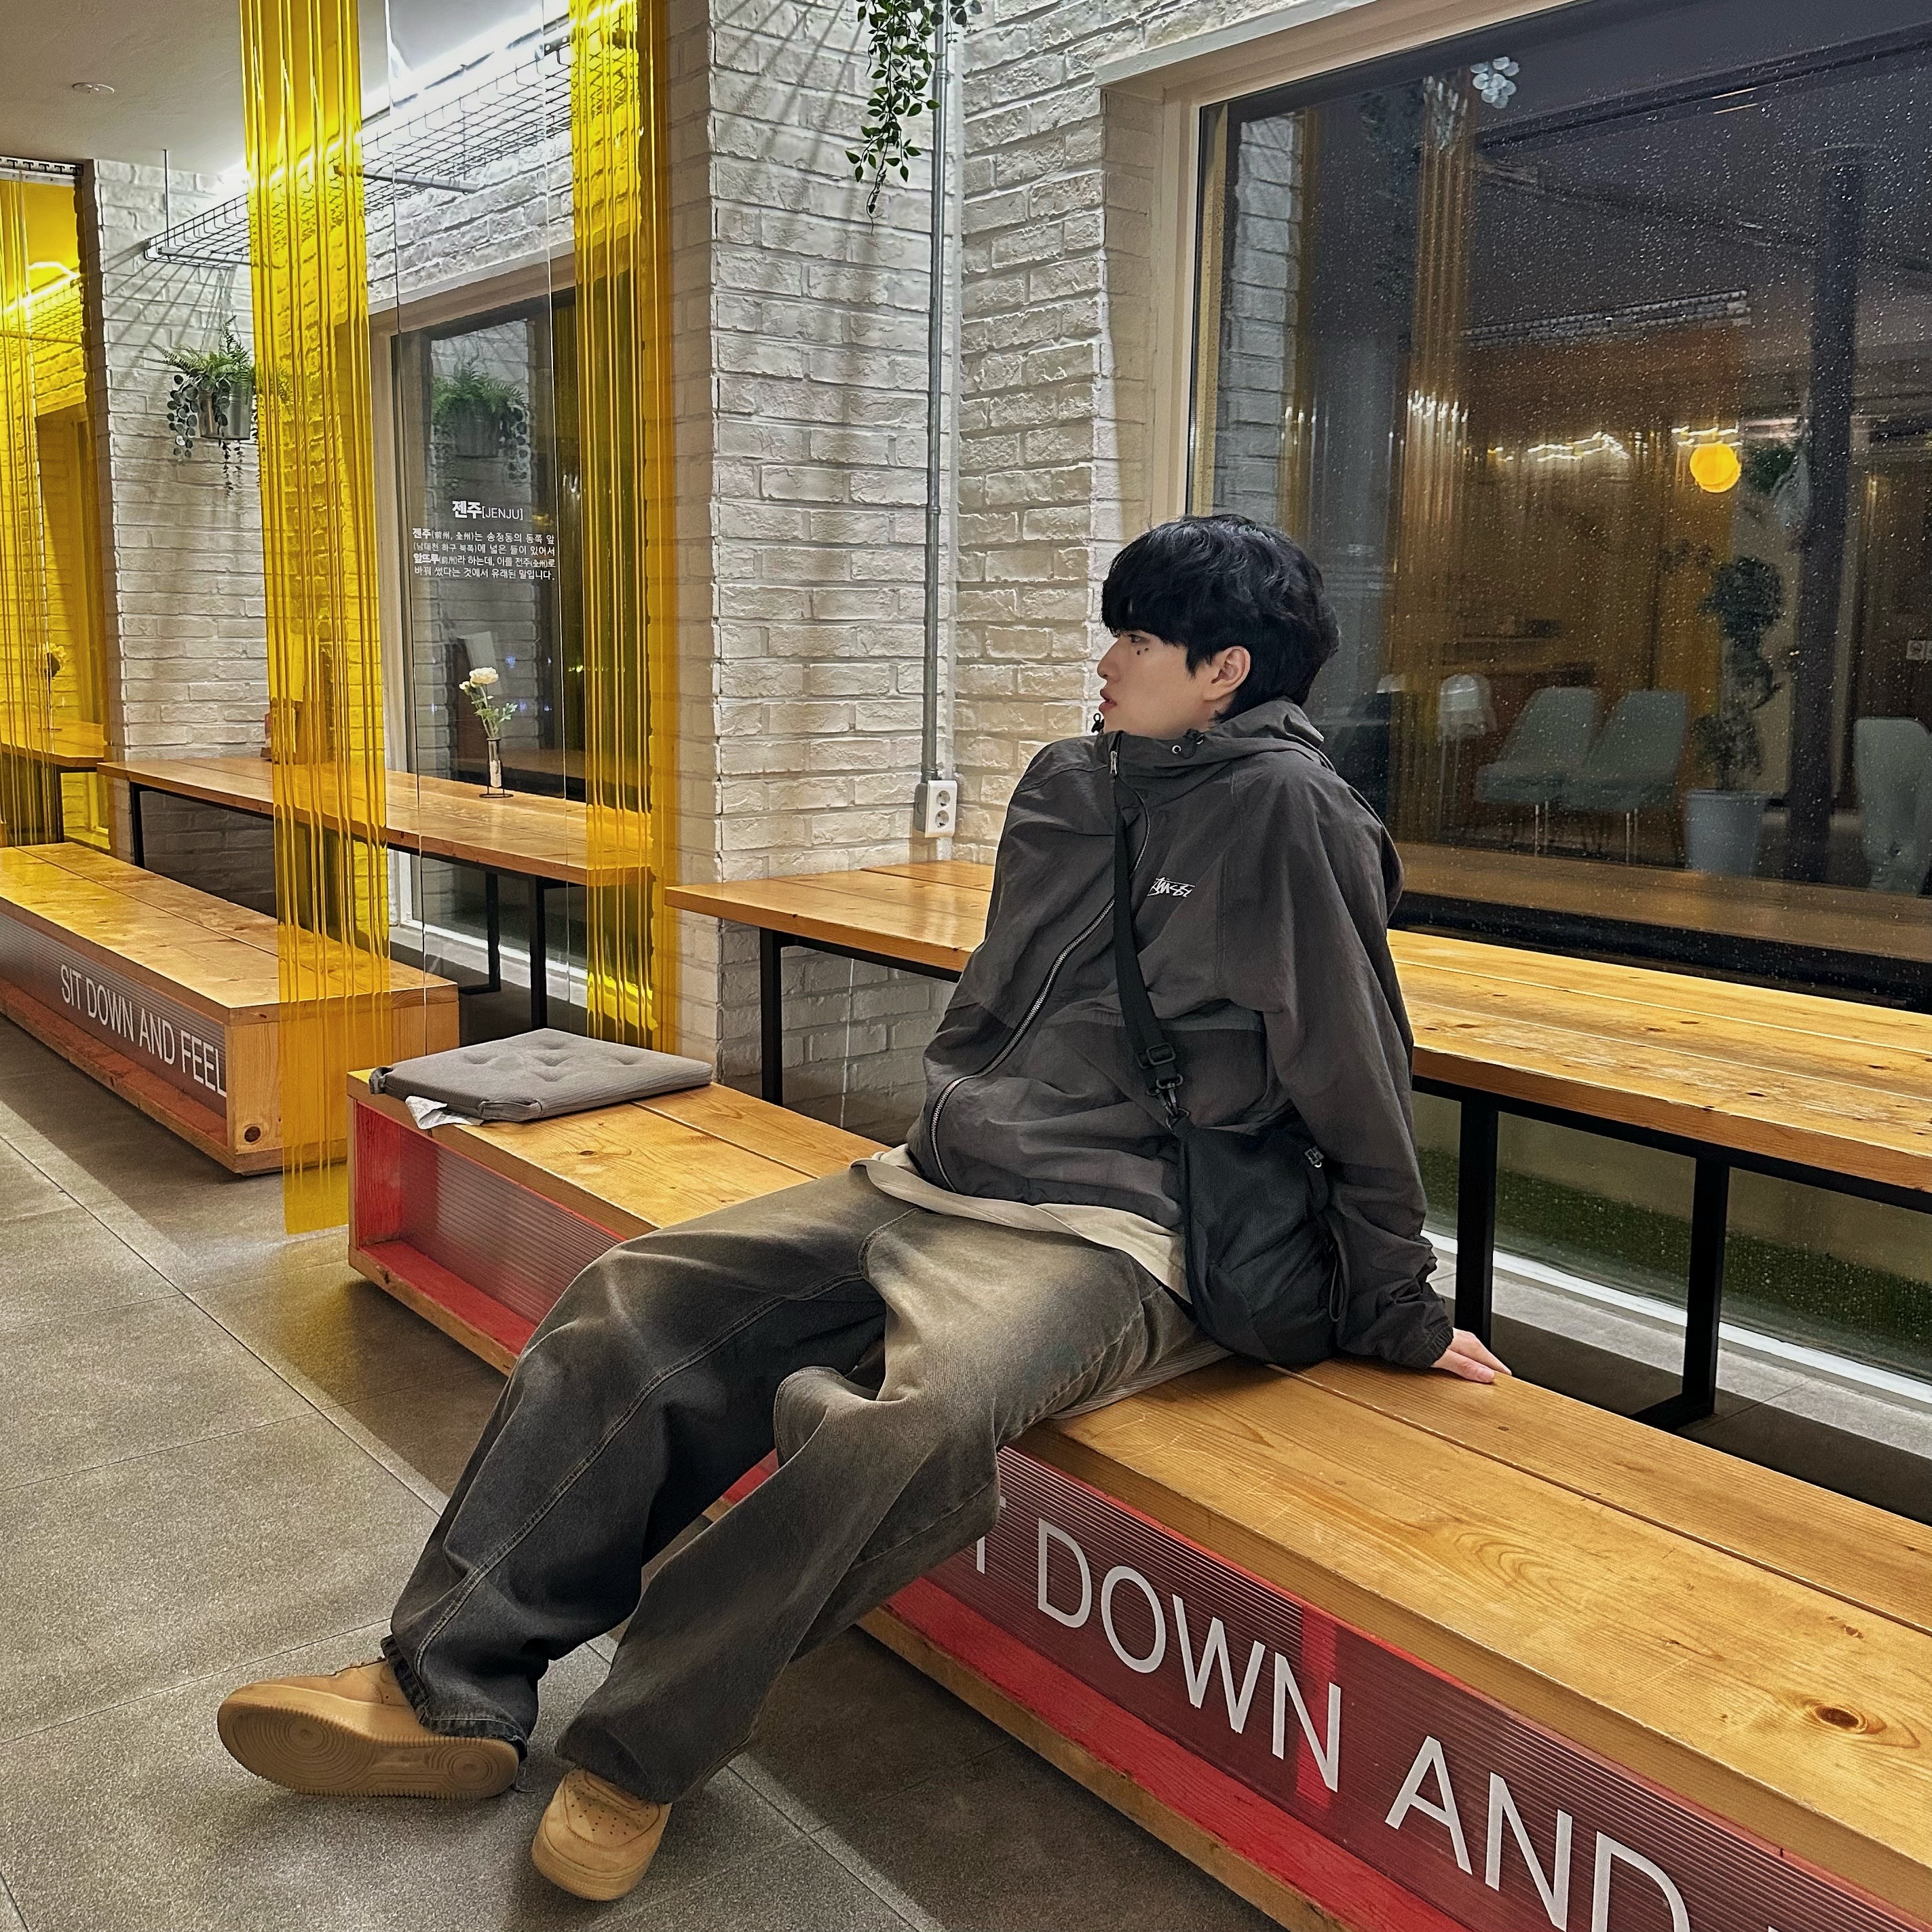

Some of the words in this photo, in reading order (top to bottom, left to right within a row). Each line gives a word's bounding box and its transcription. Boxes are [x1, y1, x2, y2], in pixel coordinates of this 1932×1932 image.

[452, 500, 523, 521] 젠주[JENJU]
[487, 531, 522, 543] 송정동의
[526, 533, 542, 544] 동쪽
[546, 534, 554, 545] 앞
[413, 542, 439, 552] (남대천
[441, 543, 457, 552] 하구
[459, 544, 486, 554] 북쪽)에
[489, 544, 507, 554] 넓은
[510, 545, 527, 555] 들이
[530, 546, 555, 556] 있어서
[467, 555, 495, 567] 하는데,
[497, 556, 512, 567] 이를
[414, 565, 432, 576] 바꿔
[434, 567, 461, 577] 썼다는
[463, 567, 489, 578] 것에서
[491, 568, 516, 579] 유래된
[518, 569, 555, 581] 말입니다.
[60, 964, 82, 1010] SIT
[86, 977, 134, 1042] DOWN
[139, 1008, 176, 1065] AND
[181, 1029, 227, 1098] FEEL
[1038, 1517, 1342, 1793] DOWN
